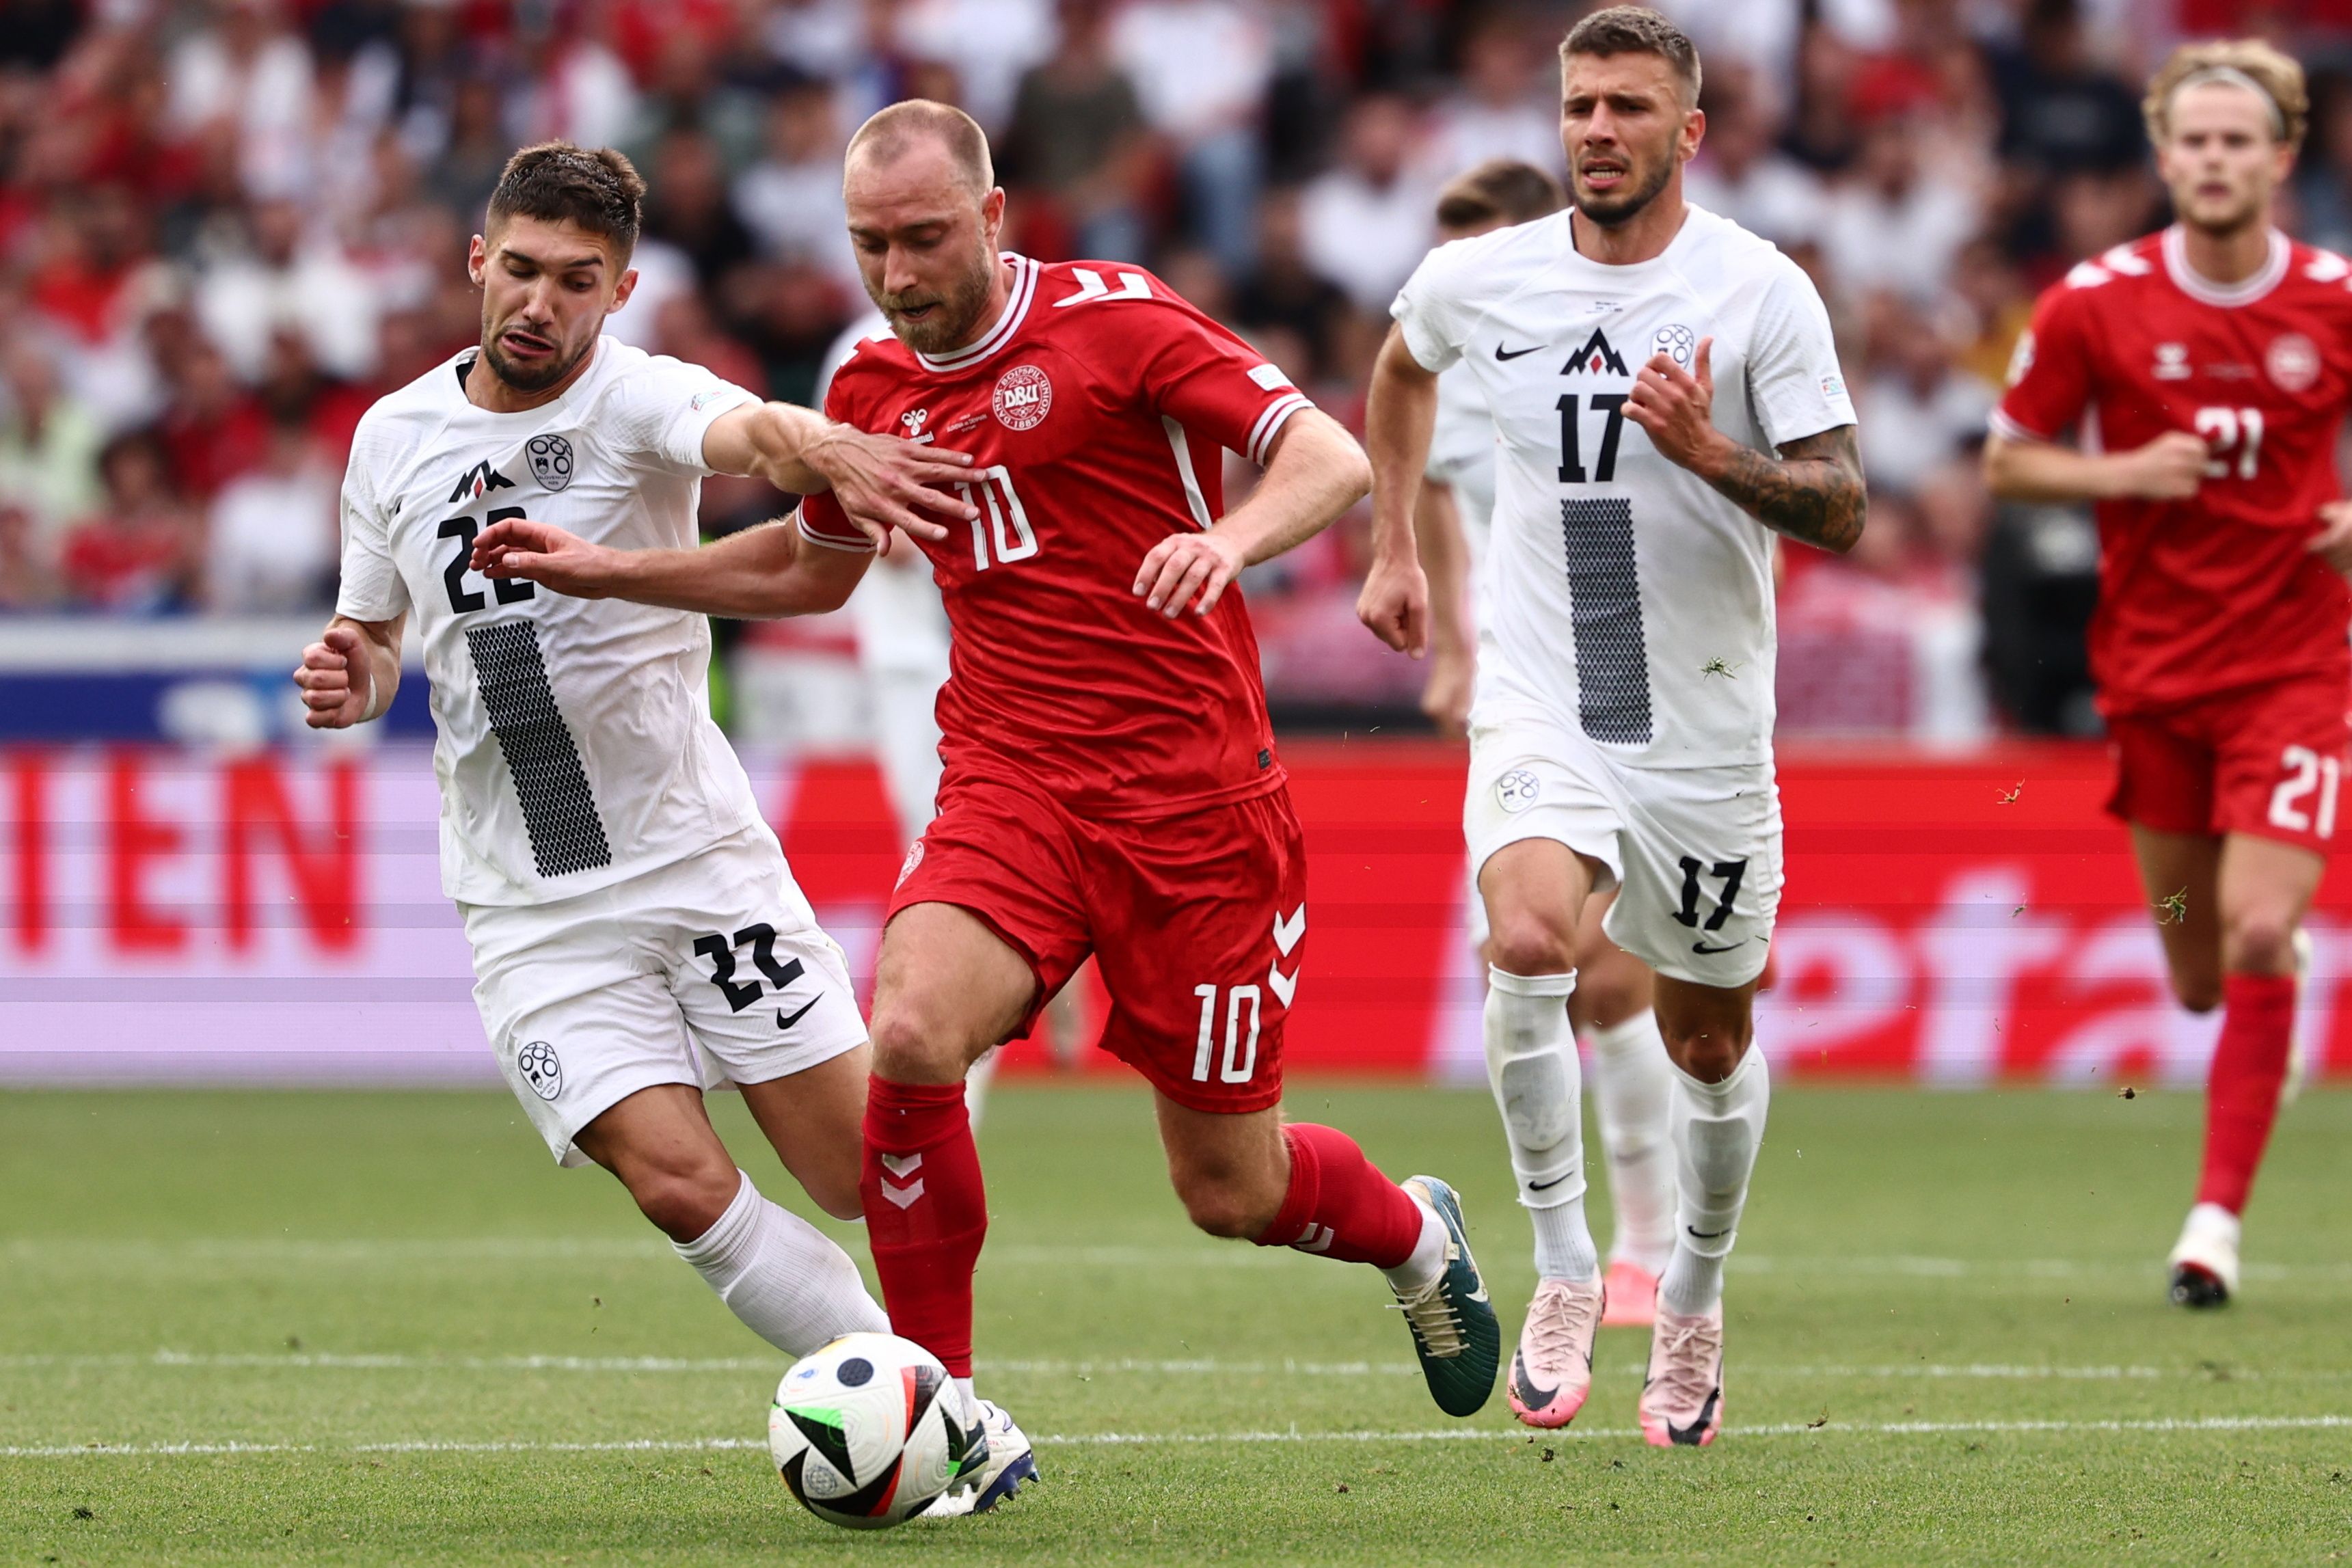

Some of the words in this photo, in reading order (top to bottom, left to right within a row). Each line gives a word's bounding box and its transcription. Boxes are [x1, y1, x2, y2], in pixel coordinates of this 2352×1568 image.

[1004, 384, 1040, 409] DBU
[1014, 416, 1038, 429] 1889
[1037, 379, 1050, 416] UNION
[1555, 394, 1630, 483] 17
[2194, 405, 2264, 480] 21
[954, 464, 1038, 571] 10
[2267, 744, 2339, 840] 21
[1671, 856, 1748, 931] 17
[693, 922, 805, 1014] 22
[1192, 984, 1260, 1083] 10
